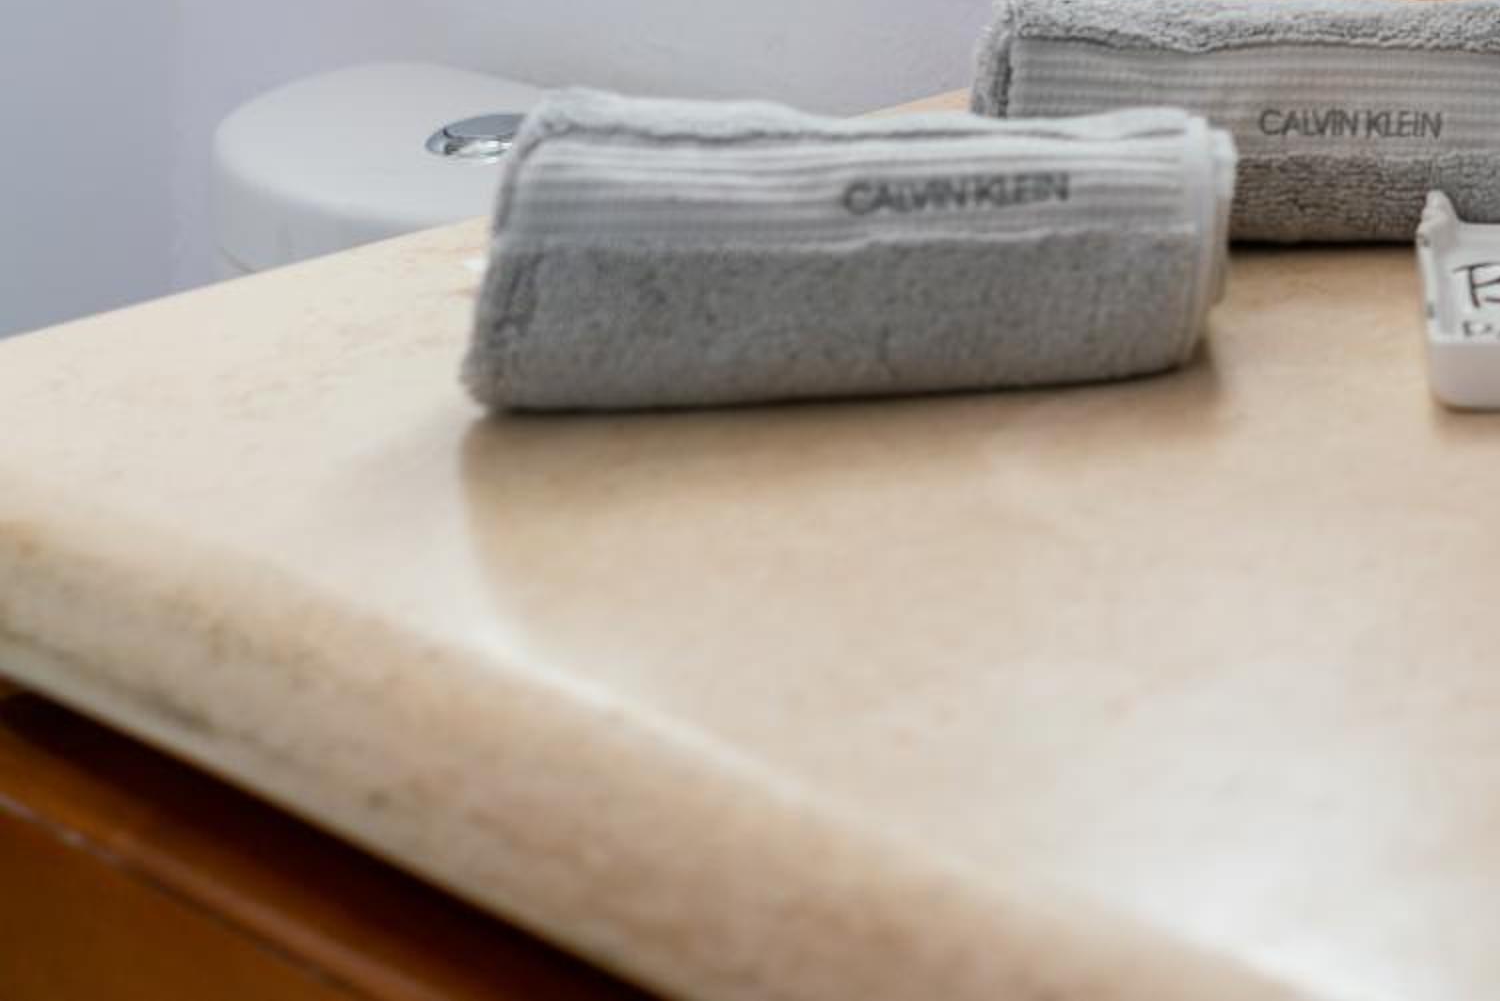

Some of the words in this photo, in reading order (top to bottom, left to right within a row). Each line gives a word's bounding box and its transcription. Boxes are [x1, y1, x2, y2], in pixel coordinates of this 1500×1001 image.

[1259, 108, 1358, 136] CALVIN
[1366, 109, 1442, 139] KLEIN
[843, 175, 966, 215] CALVIN
[973, 171, 1069, 209] KLEIN
